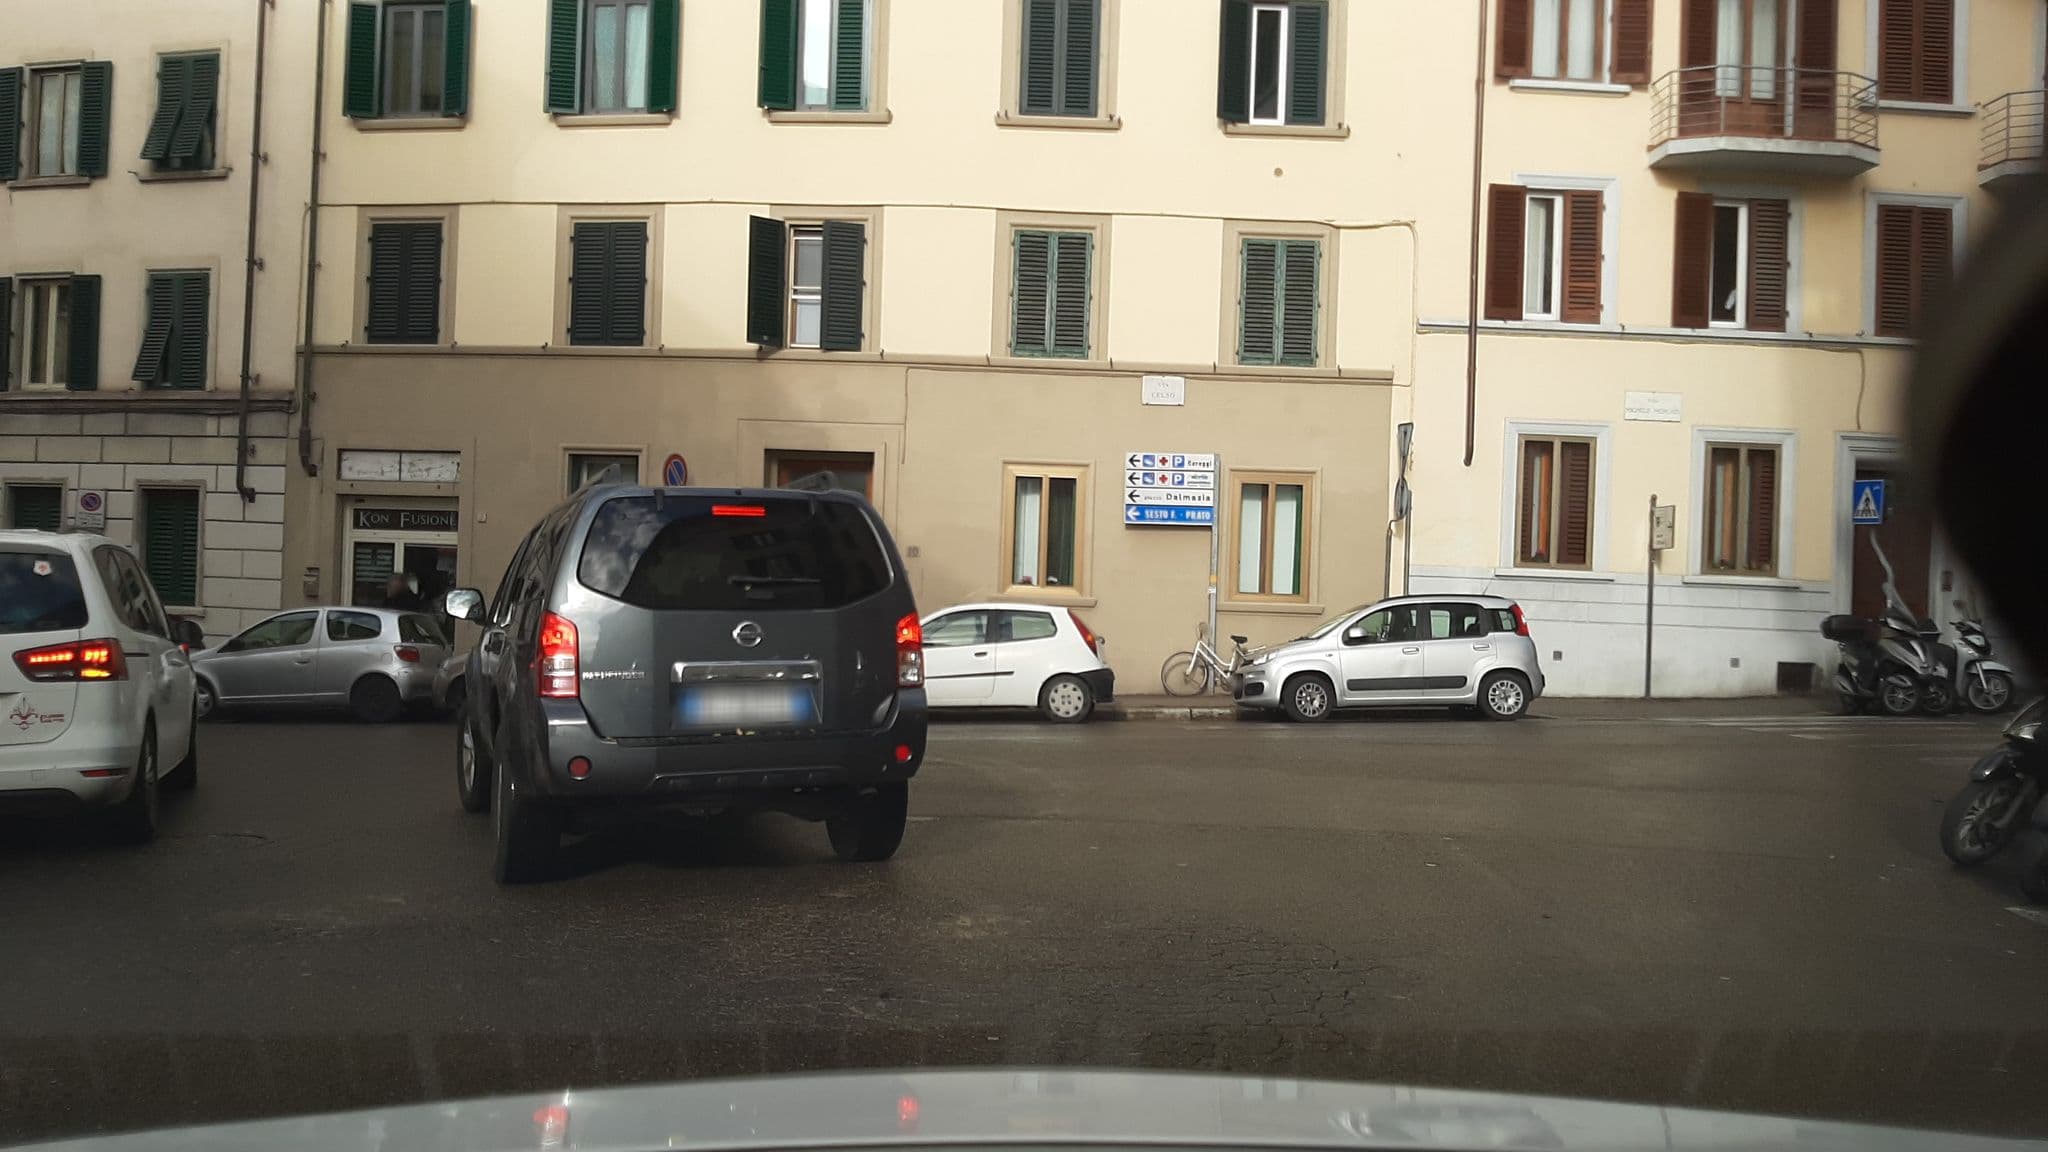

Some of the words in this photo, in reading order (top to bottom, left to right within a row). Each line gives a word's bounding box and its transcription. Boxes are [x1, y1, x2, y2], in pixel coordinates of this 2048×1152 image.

[1187, 460, 1212, 468] Careggi
[1166, 493, 1211, 501] Dalmazia
[1144, 509, 1169, 519] SESTO
[1185, 510, 1211, 520] PRATO
